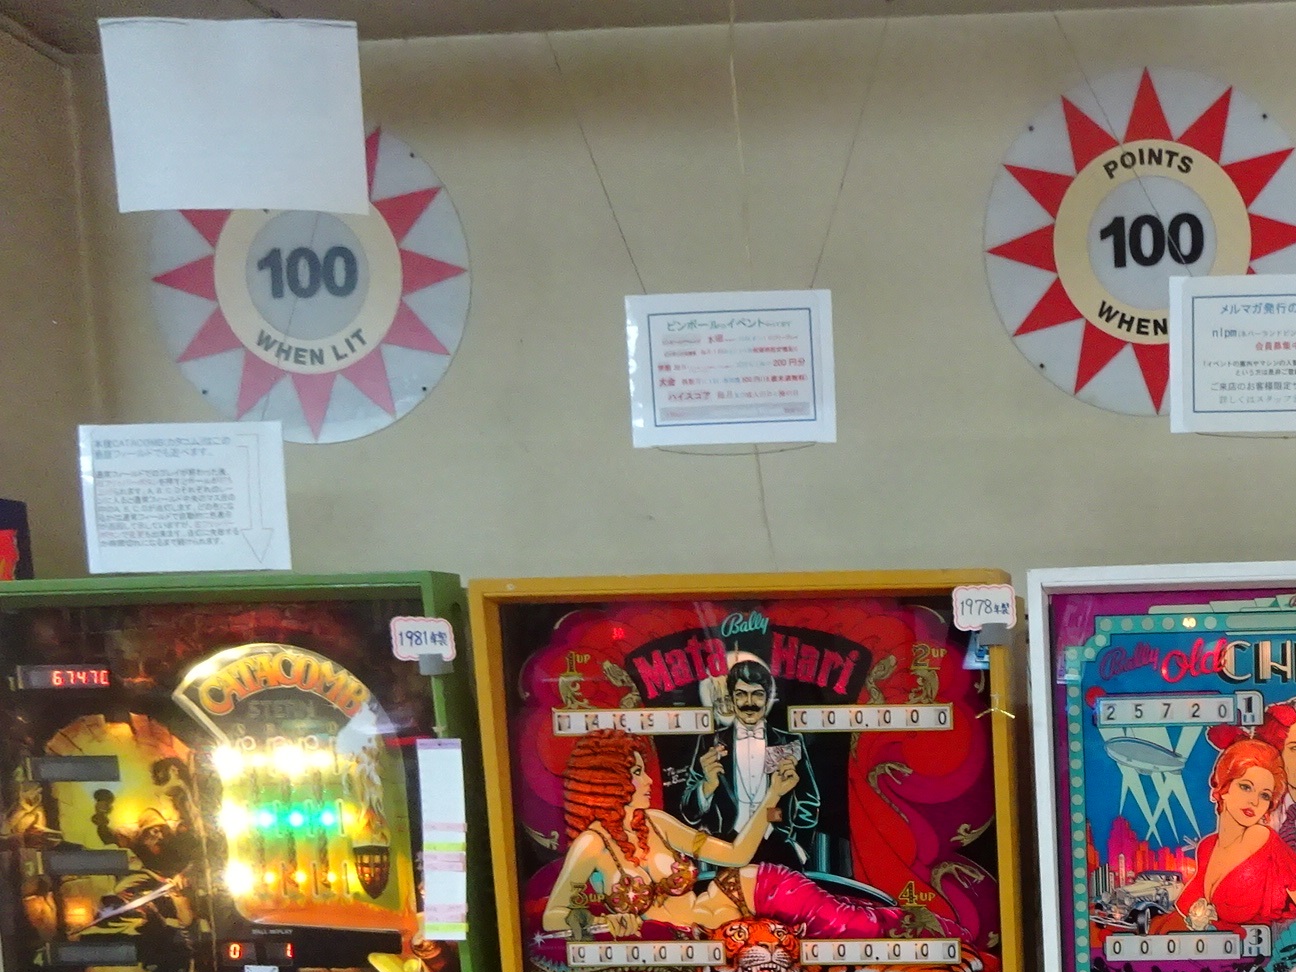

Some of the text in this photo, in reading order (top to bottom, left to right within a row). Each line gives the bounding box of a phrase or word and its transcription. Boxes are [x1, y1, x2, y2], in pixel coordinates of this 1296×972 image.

[1103, 148, 1194, 180] POINTS
[1099, 212, 1205, 269] 100
[256, 245, 359, 300] 100
[1097, 299, 1169, 336] WHEN
[255, 327, 367, 366] WHEN LIT
[720, 610, 770, 637] Bally
[199, 651, 371, 716] CATACOMB
[632, 630, 861, 700] Mata Hari
[1100, 642, 1160, 681] Bally
[1160, 637, 1229, 684] Old
